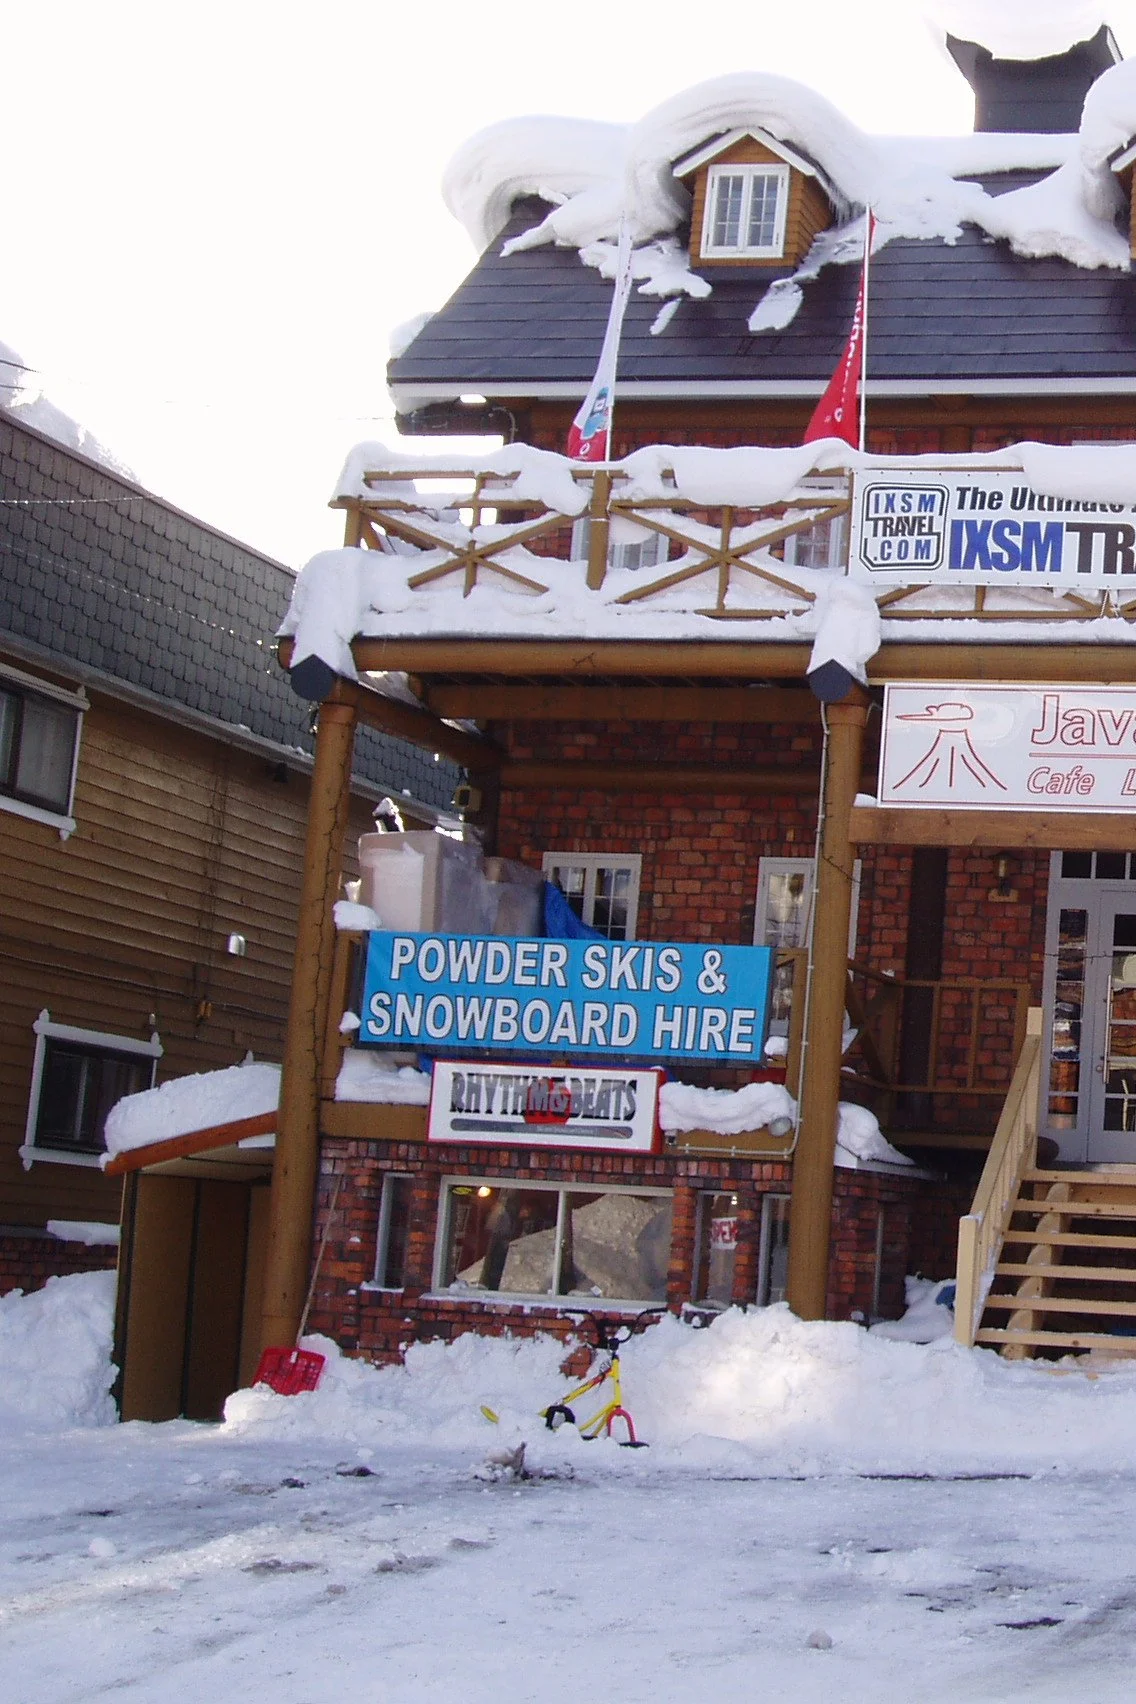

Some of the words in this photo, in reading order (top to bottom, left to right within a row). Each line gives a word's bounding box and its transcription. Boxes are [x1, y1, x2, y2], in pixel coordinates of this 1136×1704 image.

[874, 493, 936, 514] IXSM
[956, 487, 1004, 511] The
[872, 516, 938, 537] TRAVEL
[873, 539, 931, 561] .COM
[1027, 766, 1095, 795] Cafe
[390, 938, 568, 987] POWDER
[581, 945, 682, 993] SKIS
[697, 949, 728, 995] &
[366, 992, 640, 1048] SNOWBOARD
[652, 1005, 756, 1053] HIRE
[571, 1077, 637, 1121] BEATS
